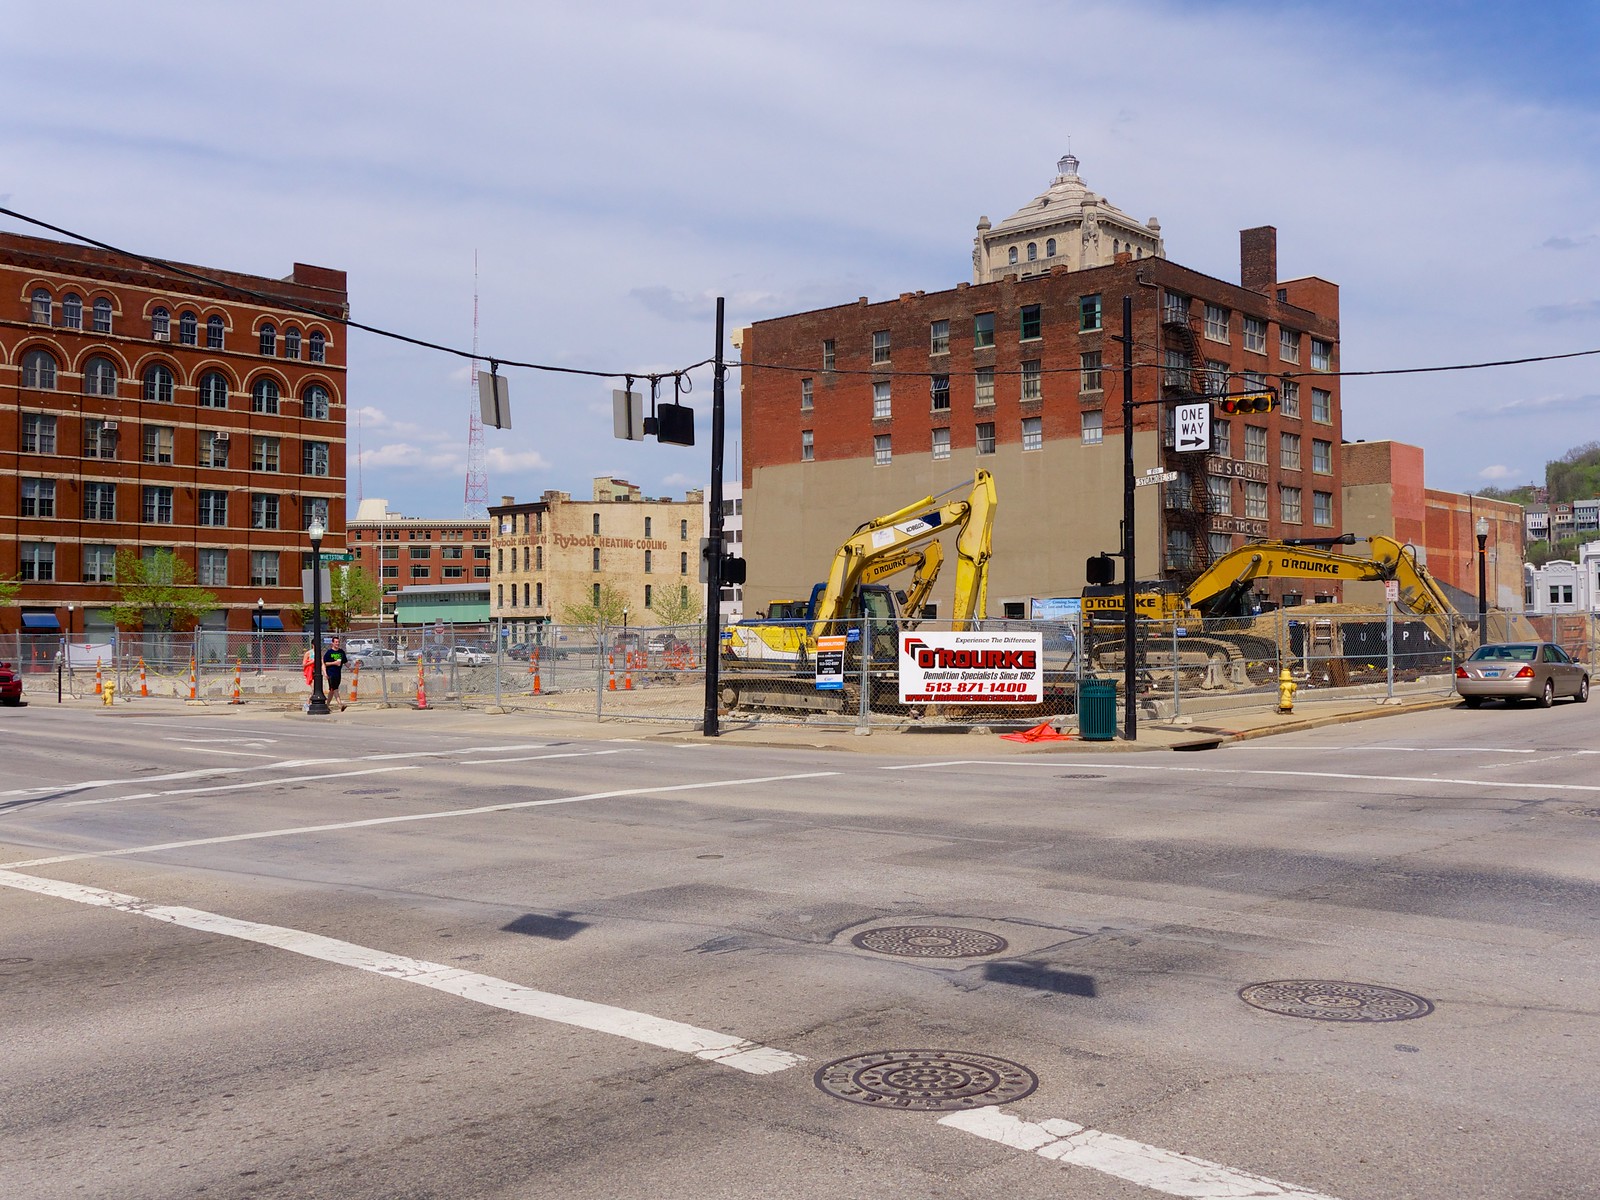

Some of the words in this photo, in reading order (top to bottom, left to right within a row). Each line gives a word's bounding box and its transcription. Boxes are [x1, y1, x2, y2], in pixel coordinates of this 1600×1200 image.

[1181, 407, 1204, 421] ONE
[1181, 422, 1204, 436] WAY
[491, 537, 517, 549] Rybolt
[553, 533, 596, 549] Rybolt
[1281, 558, 1340, 574] O'ROURKE
[1085, 598, 1156, 609] O'ROUKE
[955, 637, 990, 645] Experience
[918, 648, 1037, 669] O'ROURKE
[923, 671, 960, 680] Demolition
[960, 671, 998, 681] Specialists
[1000, 671, 1019, 680] Since
[1019, 671, 1036, 681] 1962
[925, 682, 1028, 693] 513-871-1400
